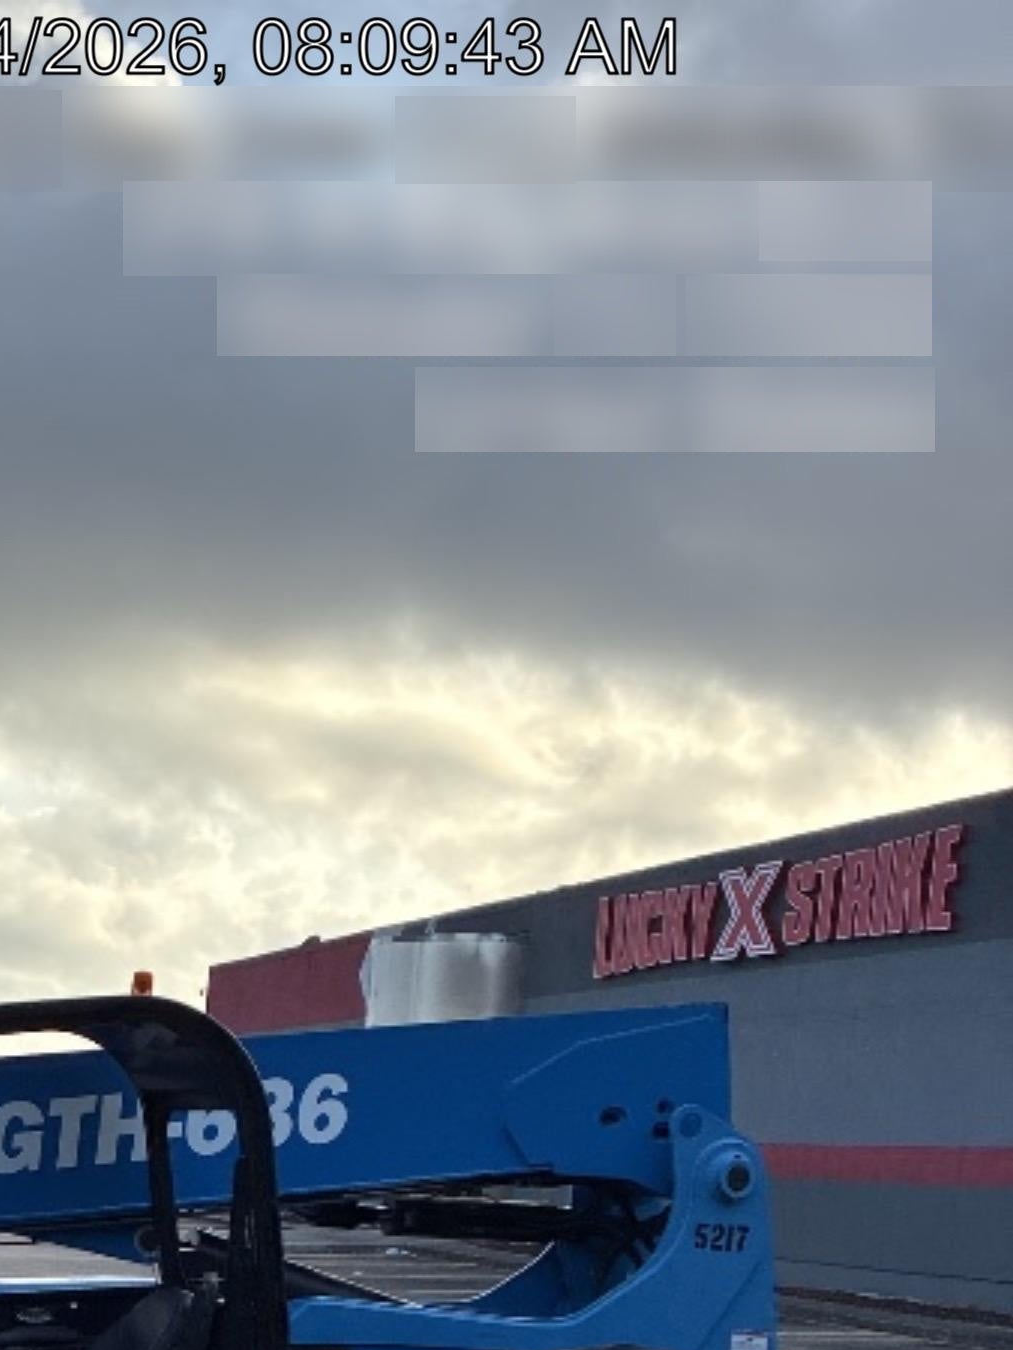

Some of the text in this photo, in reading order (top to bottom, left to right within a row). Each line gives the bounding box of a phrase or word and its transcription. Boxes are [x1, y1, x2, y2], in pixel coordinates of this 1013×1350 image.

[593, 882, 718, 980] LUCKY
[782, 824, 963, 946] STRIKE
[694, 1222, 751, 1252] 5217
